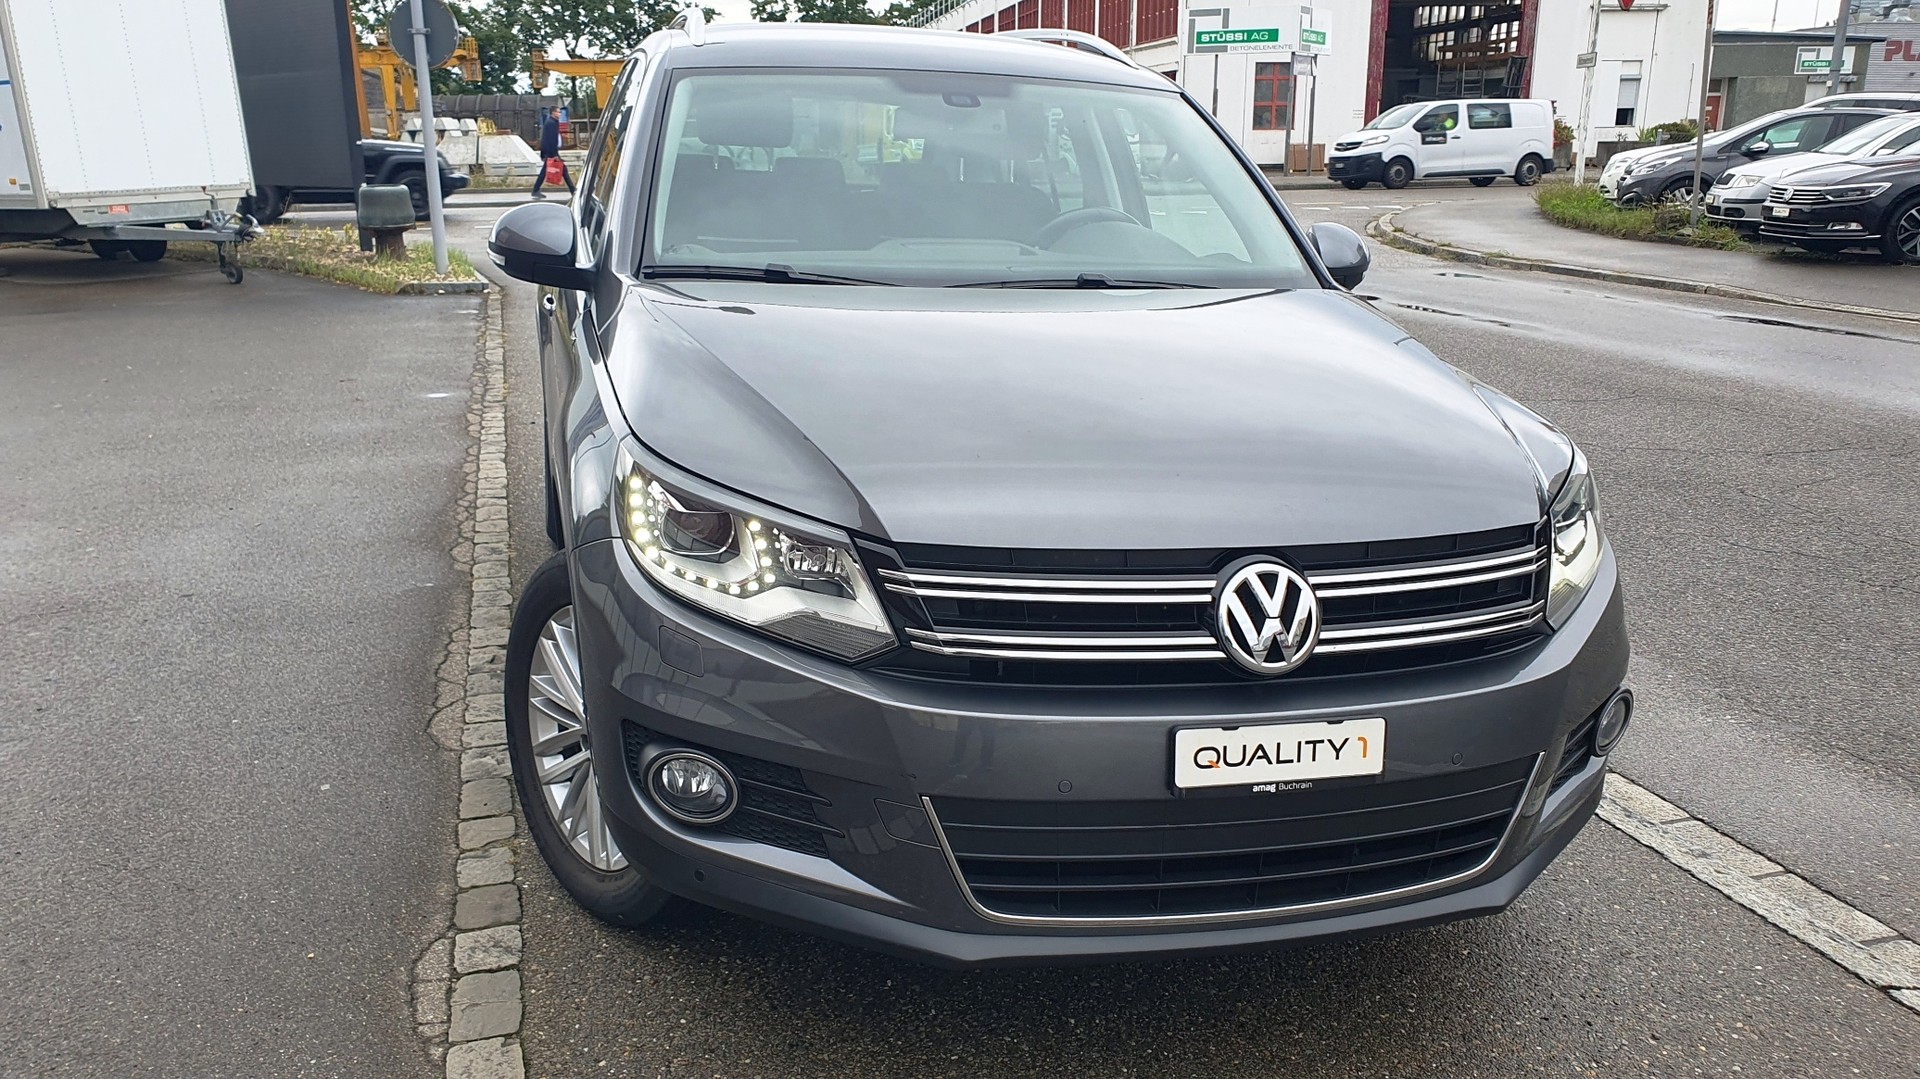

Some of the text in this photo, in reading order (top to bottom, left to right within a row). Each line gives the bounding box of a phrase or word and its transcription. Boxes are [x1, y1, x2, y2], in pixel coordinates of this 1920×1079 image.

[1200, 31, 1269, 42] STÜSSI AG
[1883, 40, 1920, 61] PL
[1193, 737, 1350, 769] QUALITY
[1252, 780, 1313, 793] amag Buchrain
